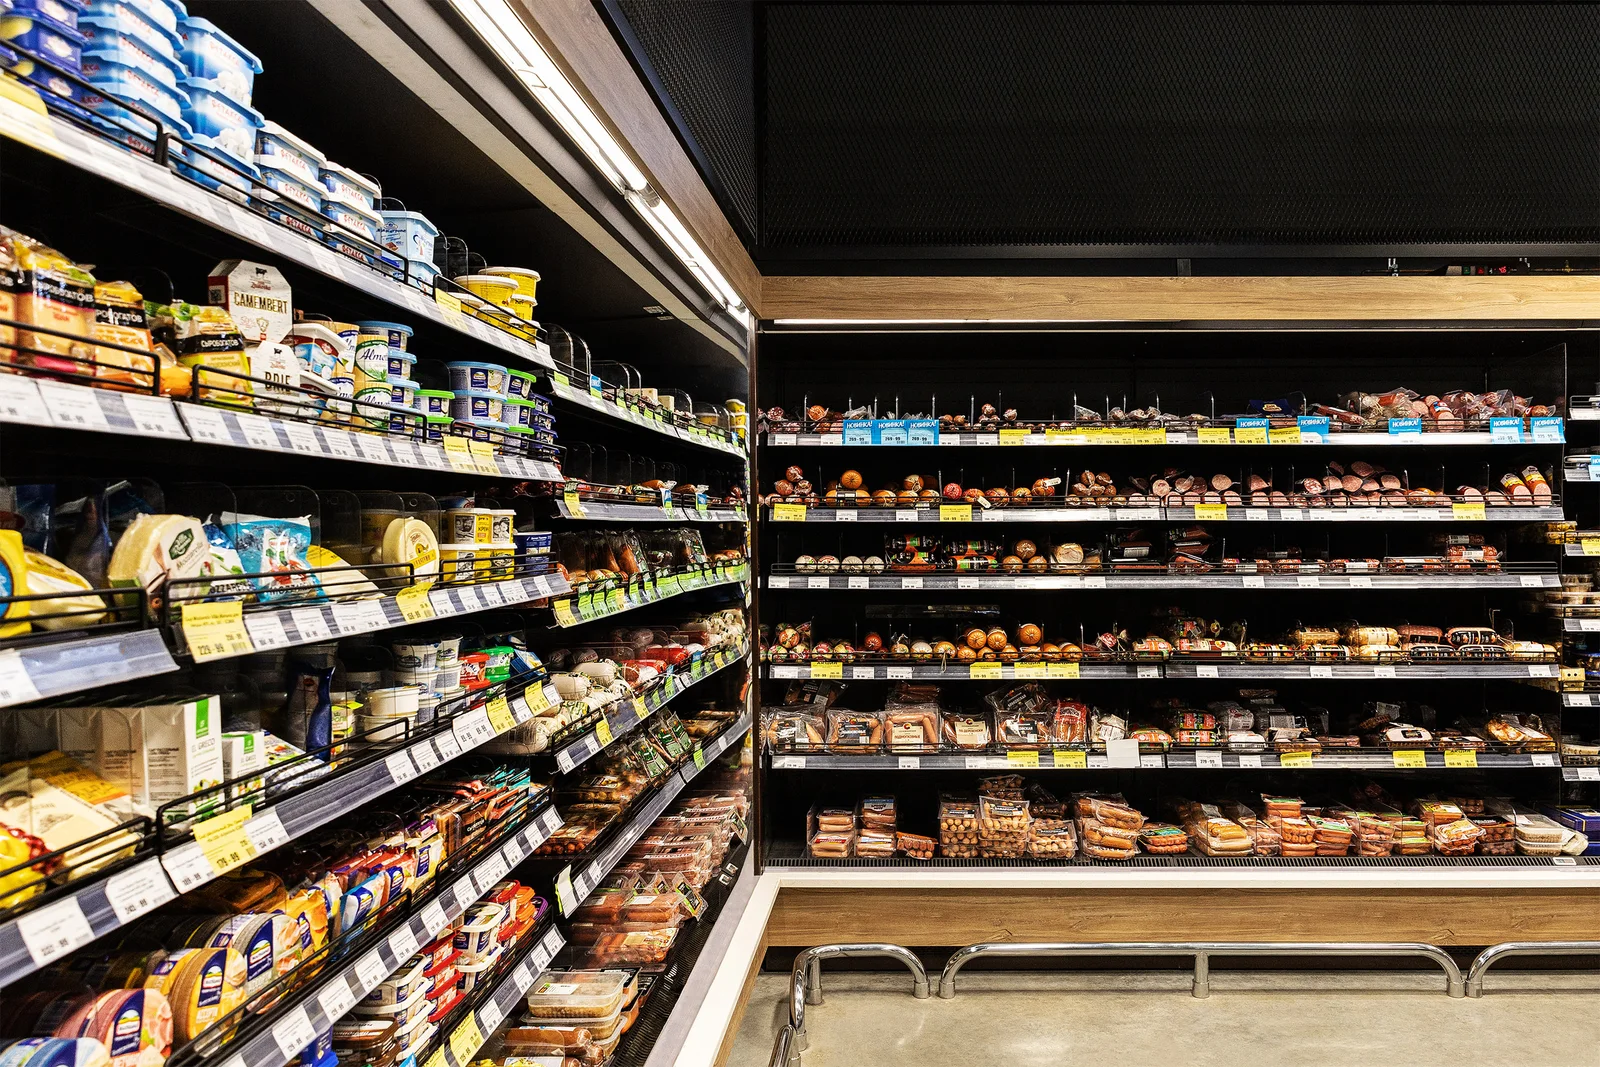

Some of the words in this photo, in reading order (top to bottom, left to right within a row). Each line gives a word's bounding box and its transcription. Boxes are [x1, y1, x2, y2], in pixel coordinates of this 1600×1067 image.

[234, 291, 288, 315] CAMEMBERT
[265, 371, 291, 394] BRIE
[846, 420, 873, 429] НОВИНКА!
[878, 420, 905, 429] НОВИНКА!
[910, 420, 937, 429] НОВИНКА!
[1240, 419, 1267, 428] НОВИНКА!
[1300, 417, 1327, 426] НОВИНКА!
[1392, 419, 1420, 428] НОВИНКА!
[1493, 418, 1520, 427] НОВИНКА!
[1534, 417, 1563, 427] НОВИНКА!
